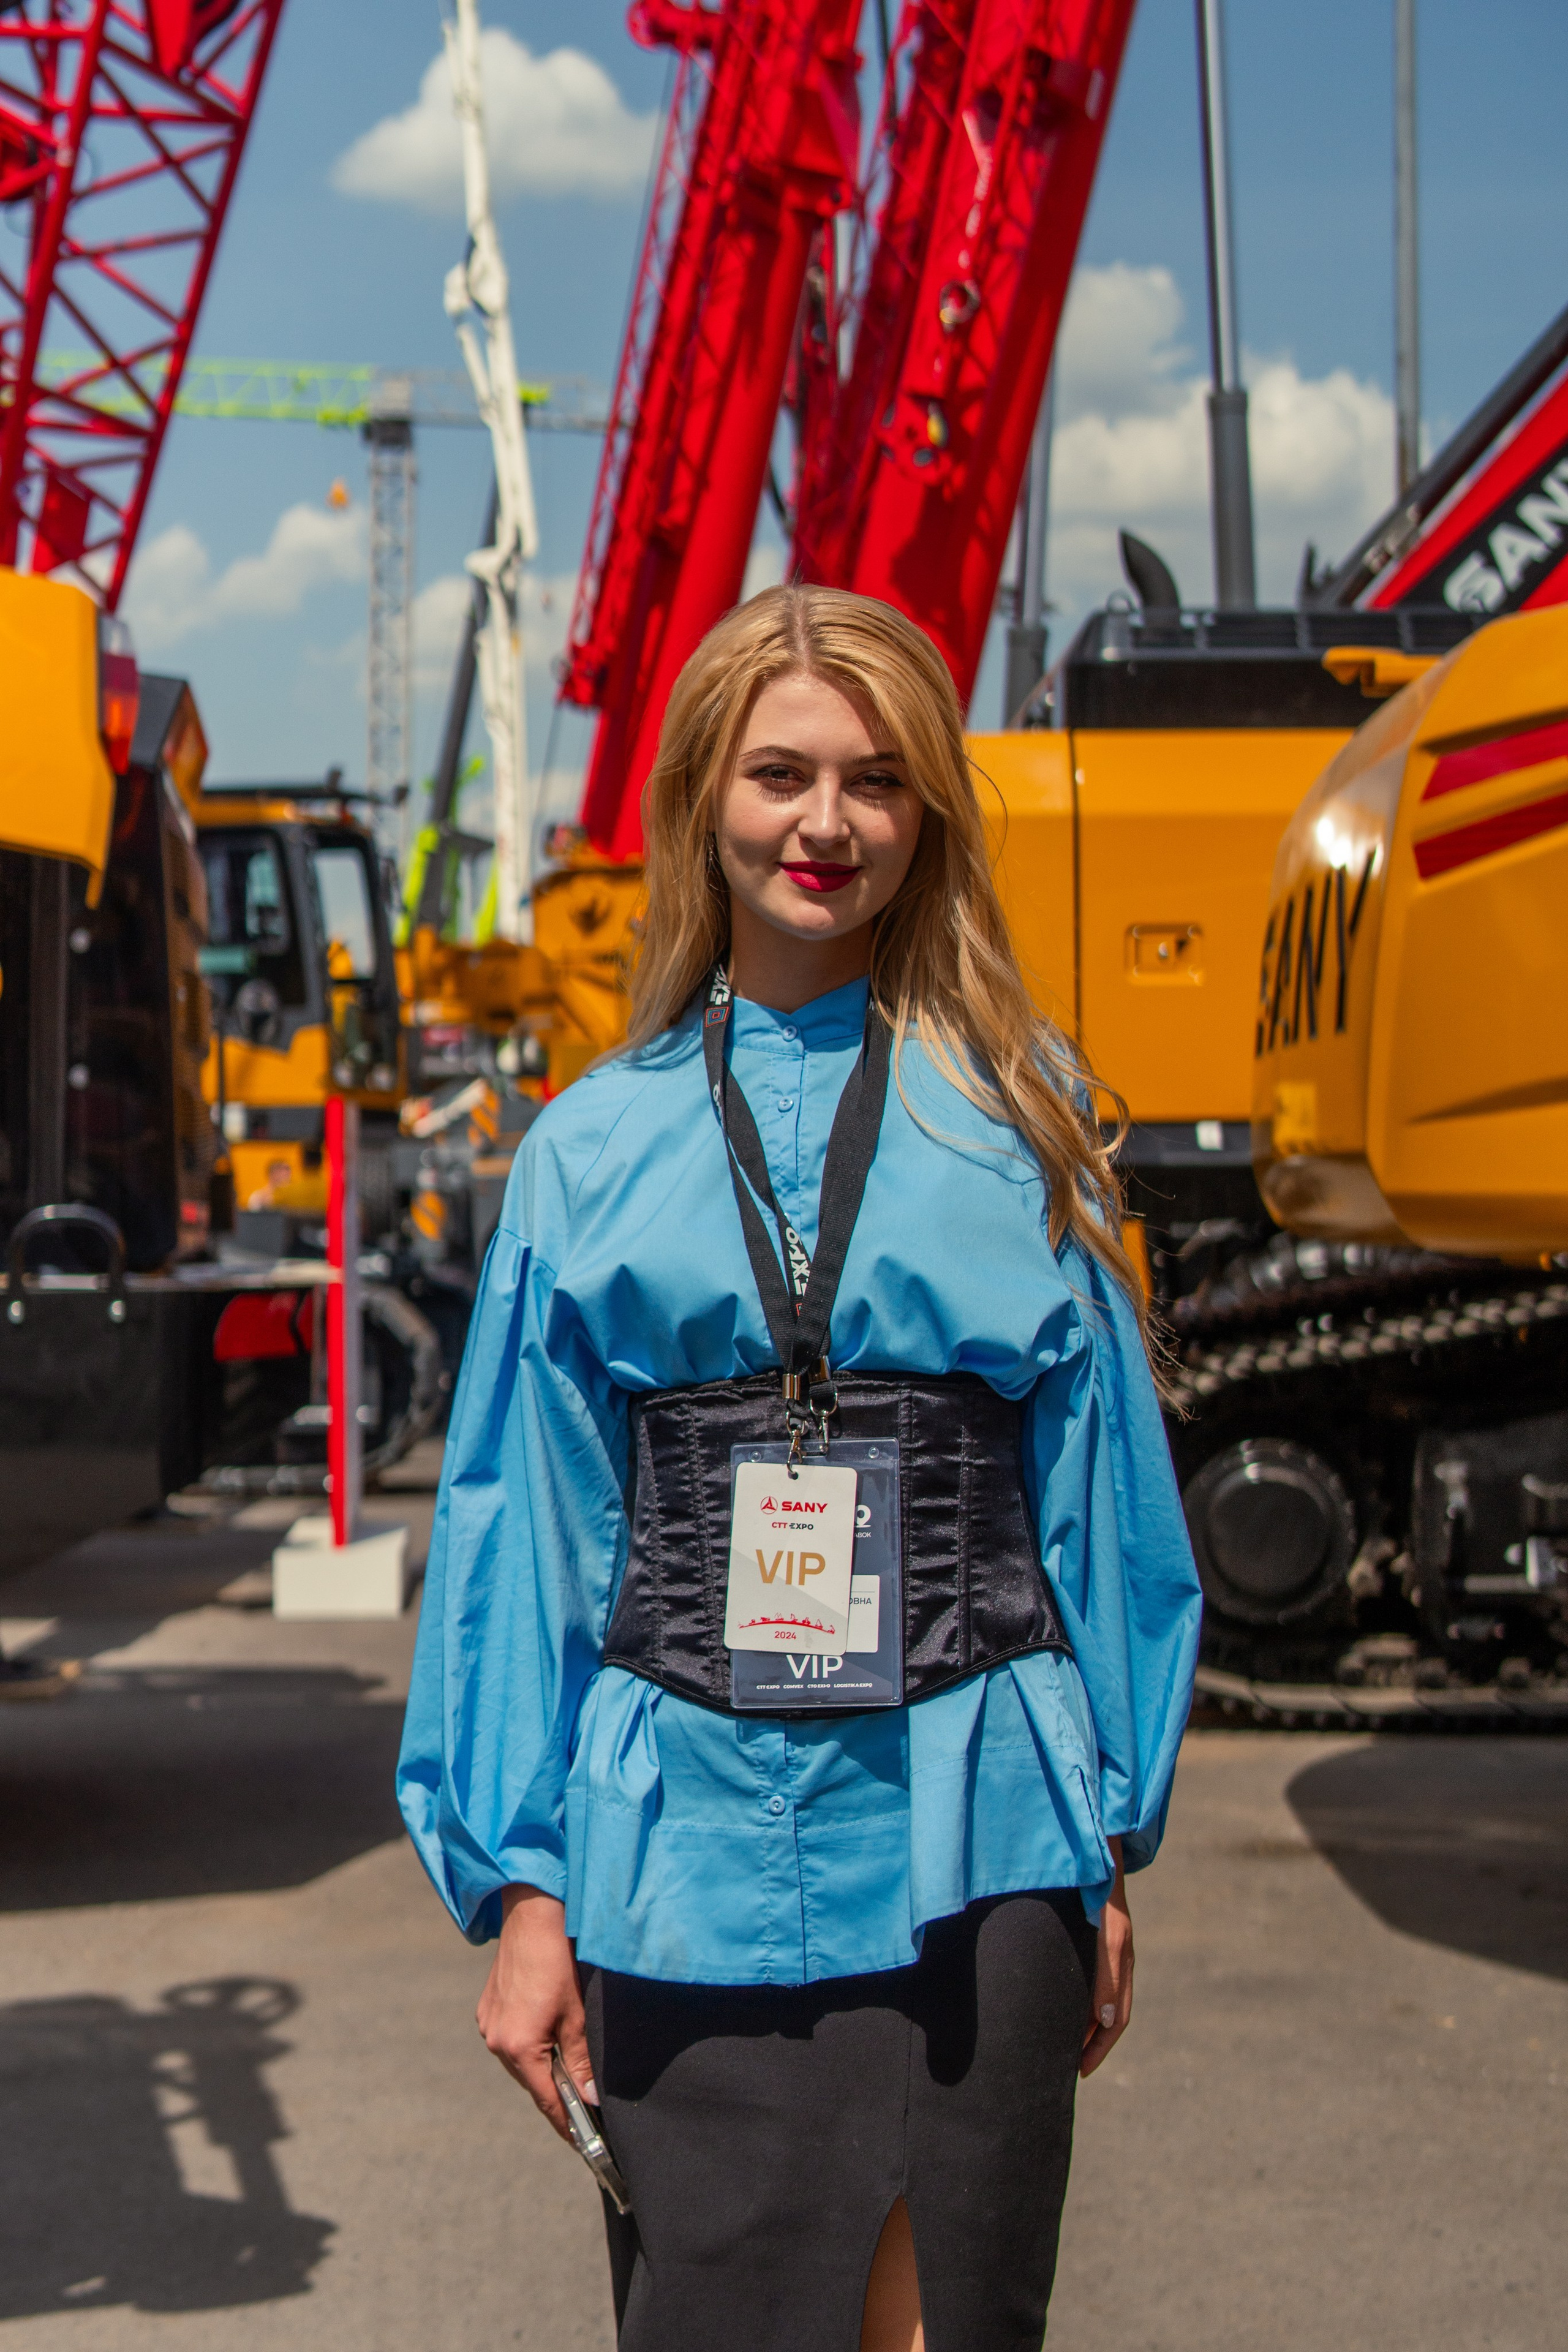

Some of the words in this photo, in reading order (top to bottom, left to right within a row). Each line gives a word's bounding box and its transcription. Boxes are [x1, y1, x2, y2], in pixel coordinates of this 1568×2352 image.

[1442, 457, 1568, 613] SAN
[782, 1501, 828, 1513] SANY
[755, 1549, 826, 1586] VIP
[774, 1630, 797, 1640] 2024
[786, 1654, 843, 1678] VIP
